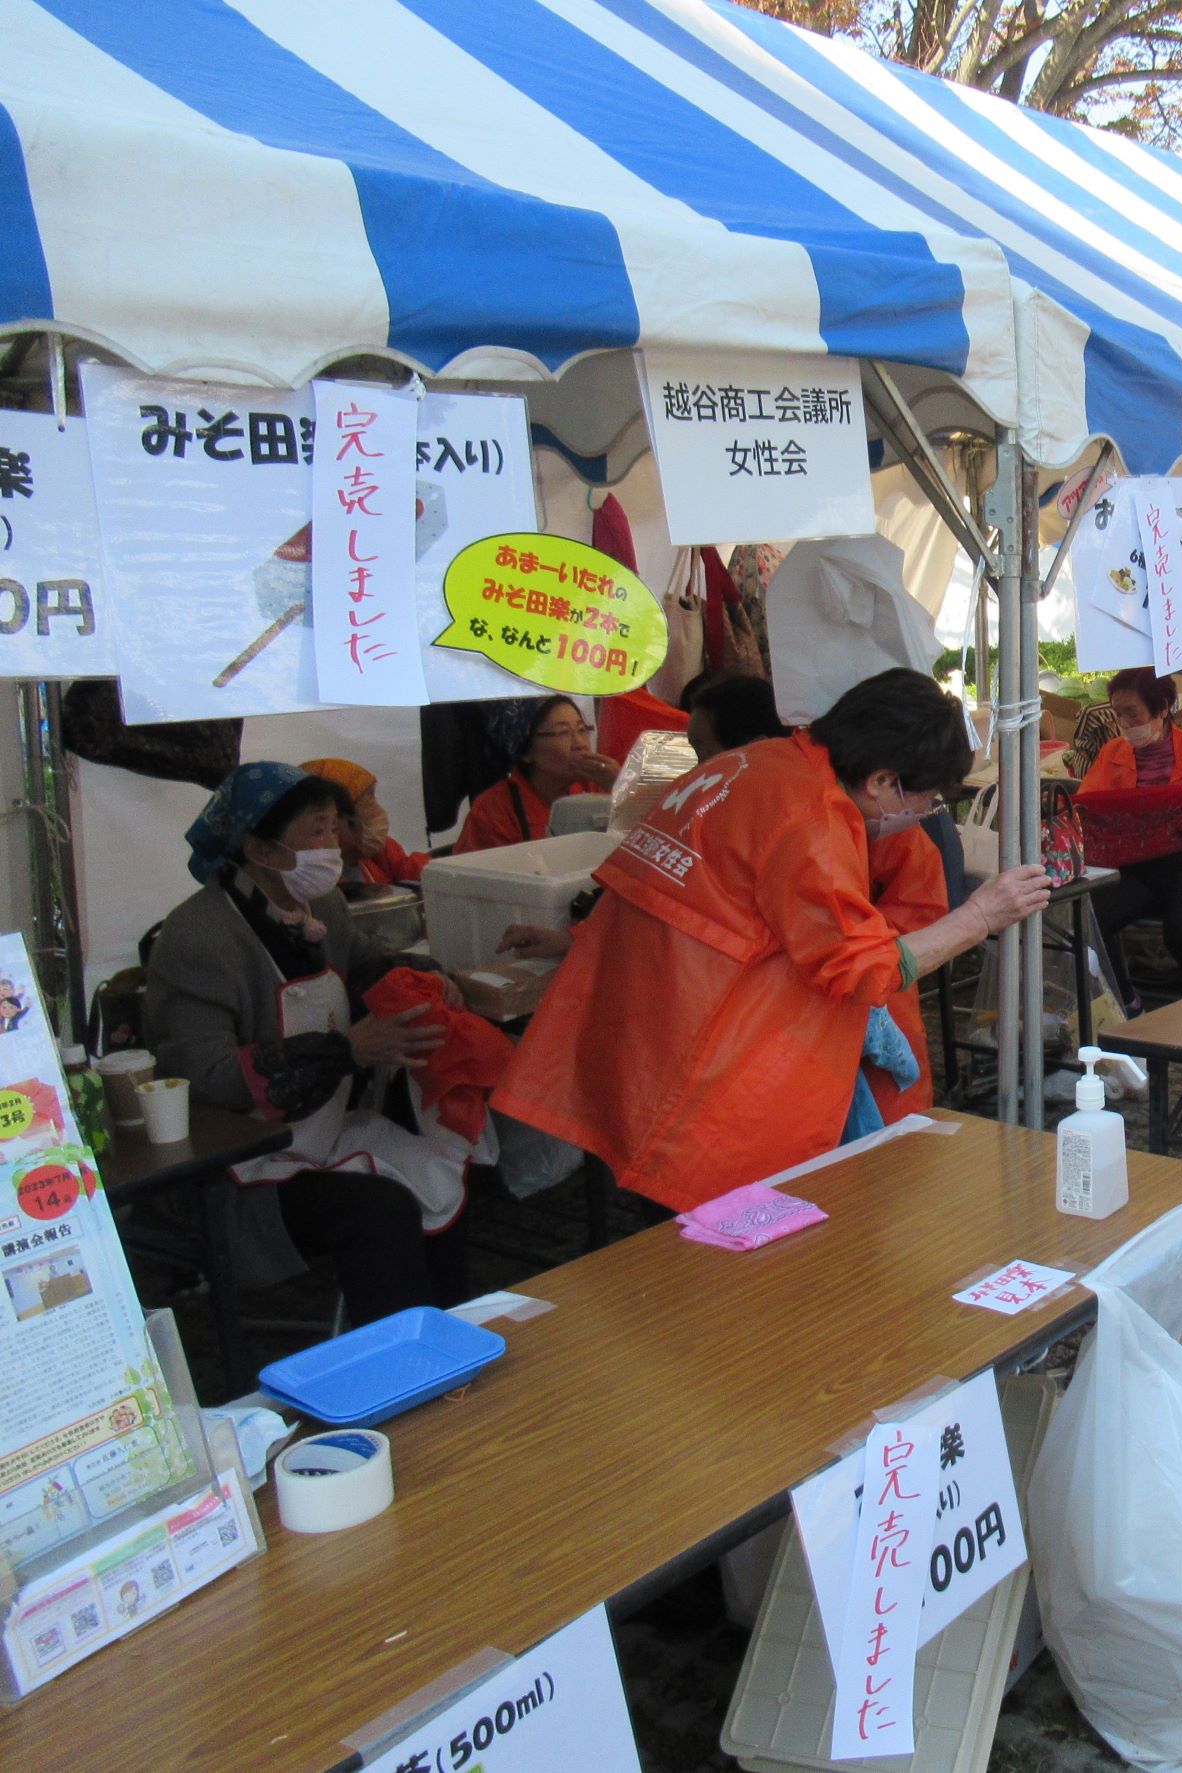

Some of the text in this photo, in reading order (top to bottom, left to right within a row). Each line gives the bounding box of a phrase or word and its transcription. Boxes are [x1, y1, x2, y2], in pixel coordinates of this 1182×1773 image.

[663, 381, 851, 425] 越谷商工会議所
[725, 440, 808, 477] 女性会
[336, 402, 398, 674] 完売しました
[495, 545, 628, 602] あまーいたれの
[1145, 503, 1182, 667] 完売しました
[482, 578, 630, 639] みそ田楽が2本で
[994, 1278, 1053, 1305] 見本
[930, 1502, 1006, 1592] 00円
[857, 1430, 922, 1740] 完売しました
